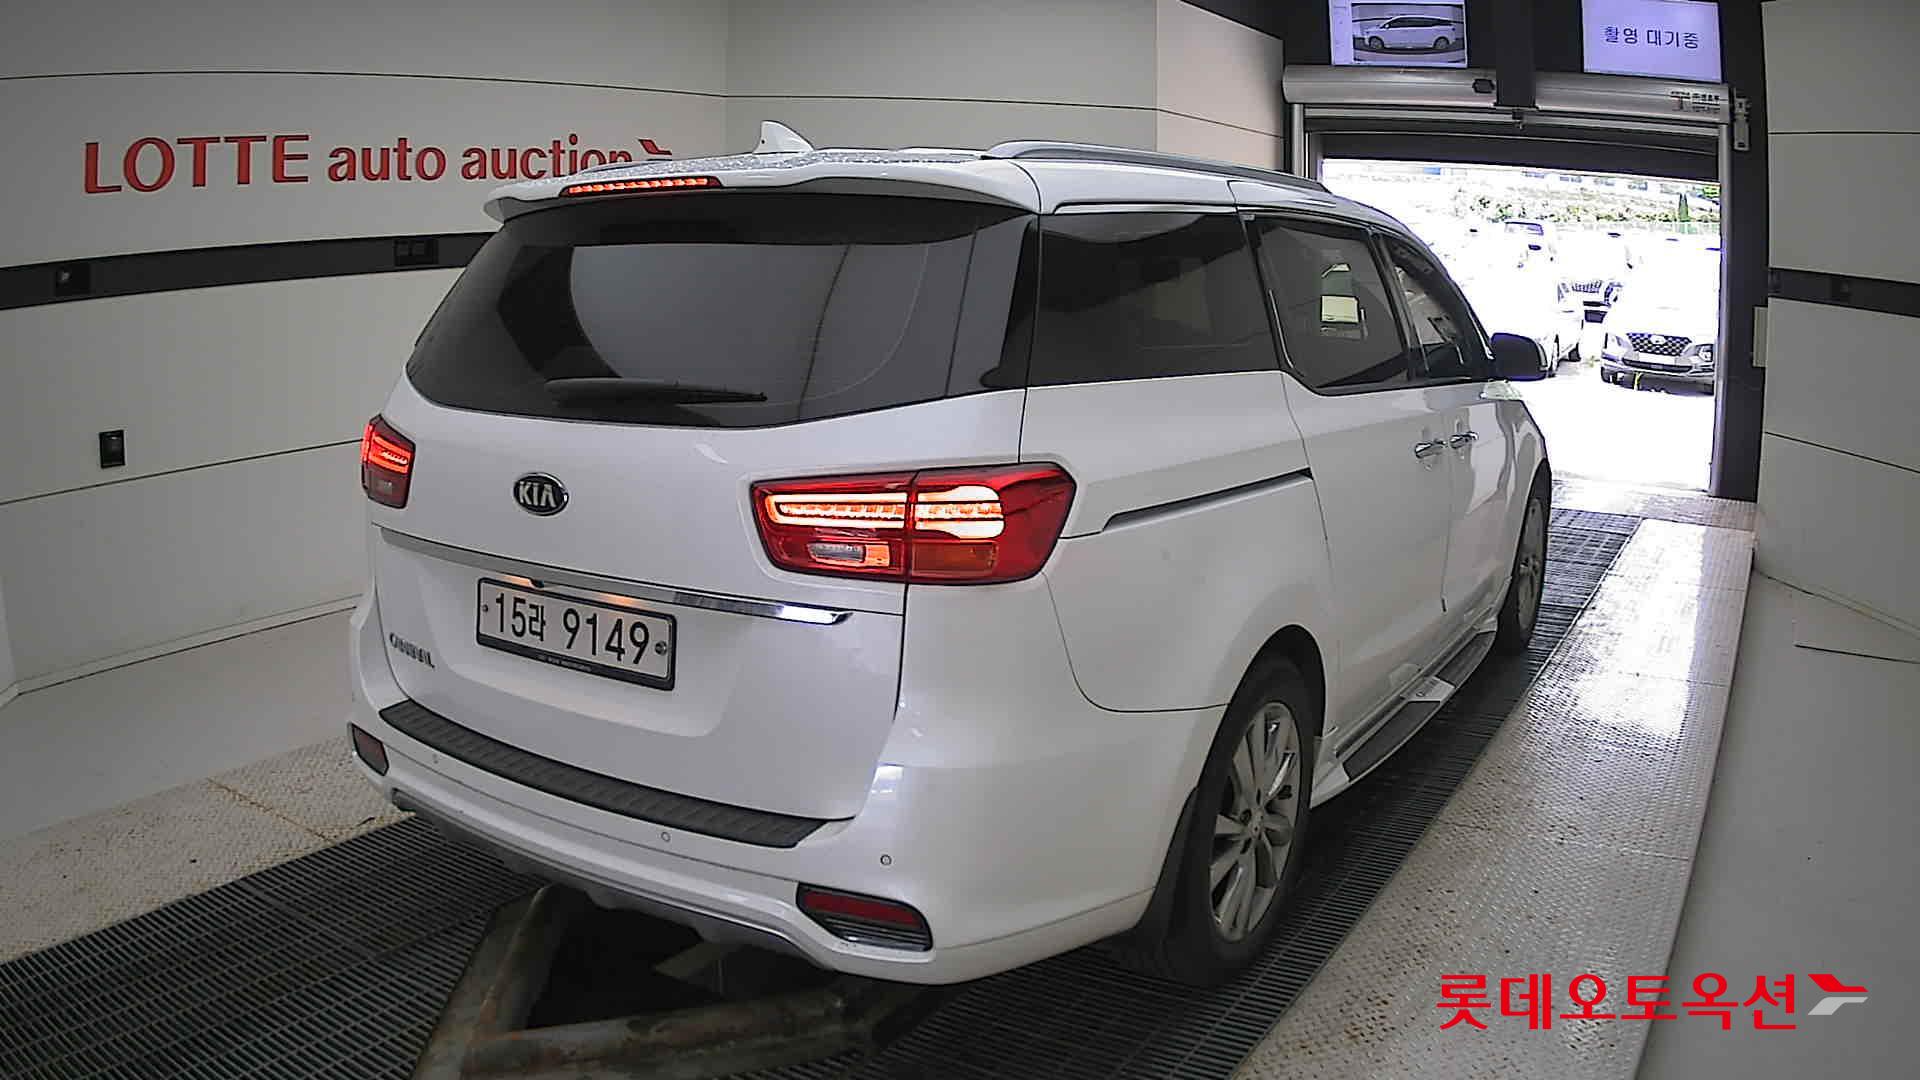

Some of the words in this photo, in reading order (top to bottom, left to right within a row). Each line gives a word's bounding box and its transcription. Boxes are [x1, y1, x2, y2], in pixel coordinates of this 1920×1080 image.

[1603, 26, 1638, 44] 촬영
[1646, 29, 1699, 49] 대기중
[84, 134, 310, 194] LOTTE
[327, 136, 446, 182] auto
[518, 480, 558, 508] KIA
[495, 592, 546, 642] 15라
[562, 607, 650, 665] 9149
